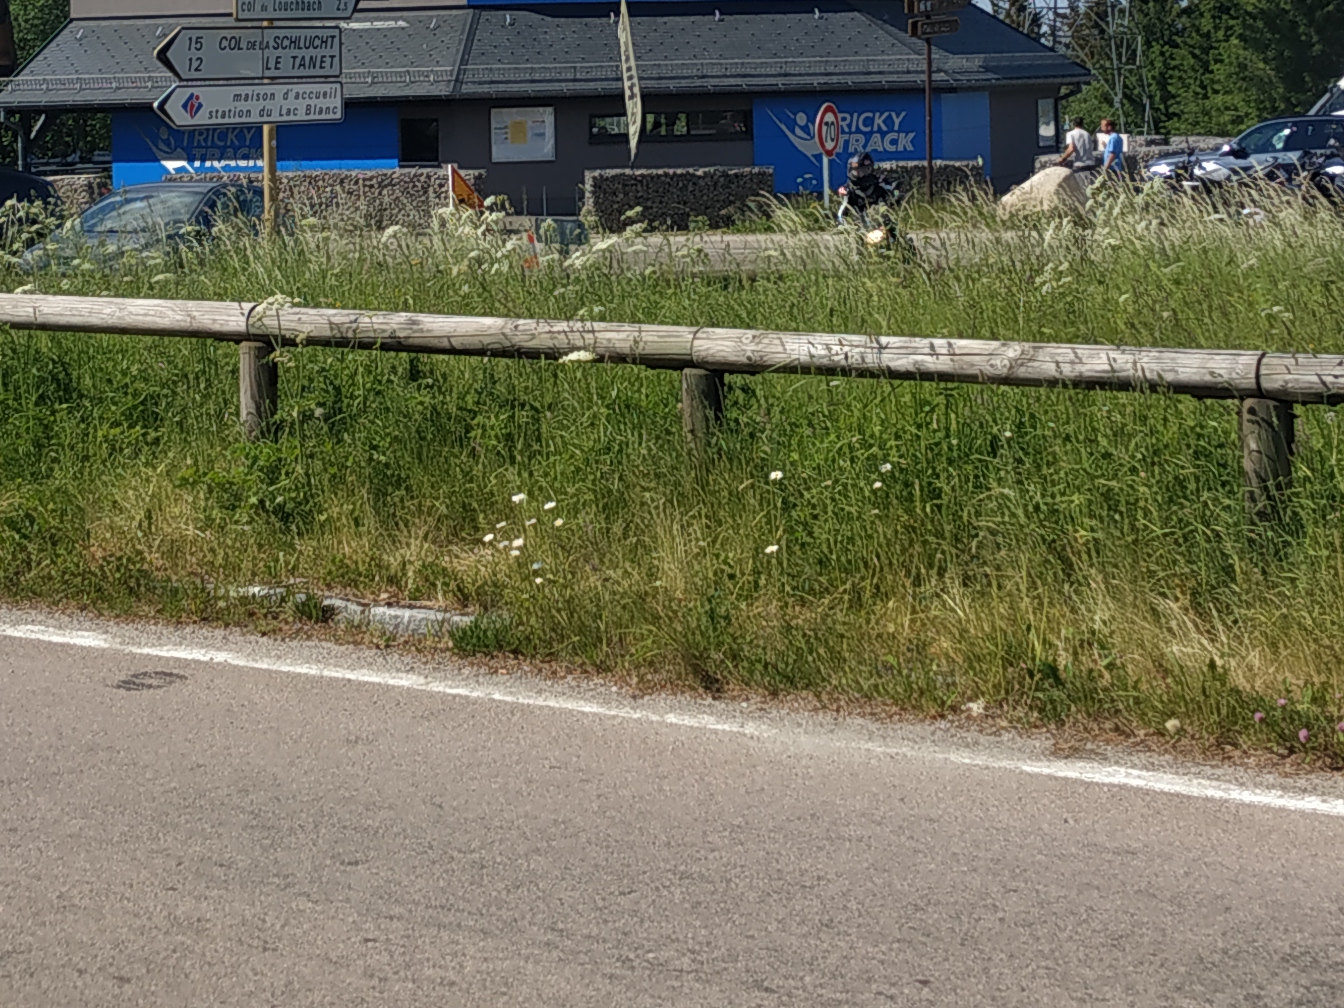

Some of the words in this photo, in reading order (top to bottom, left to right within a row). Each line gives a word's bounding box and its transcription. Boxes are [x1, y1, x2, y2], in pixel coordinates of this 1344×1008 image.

[187, 36, 204, 51] 15
[218, 36, 244, 51] COL
[246, 40, 257, 51] DE
[272, 35, 337, 51] SCHLUCHT
[187, 57, 204, 72] 12
[265, 56, 282, 71] LE
[290, 55, 337, 70] TANET
[232, 89, 276, 103] maison
[282, 87, 338, 101] d'accueil
[207, 107, 252, 120] station
[258, 106, 273, 118] du
[279, 105, 299, 117] Lac
[305, 103, 338, 117] Blanc
[838, 111, 907, 132] RICKY
[183, 127, 256, 147] TRICKY
[824, 121, 836, 143] 70
